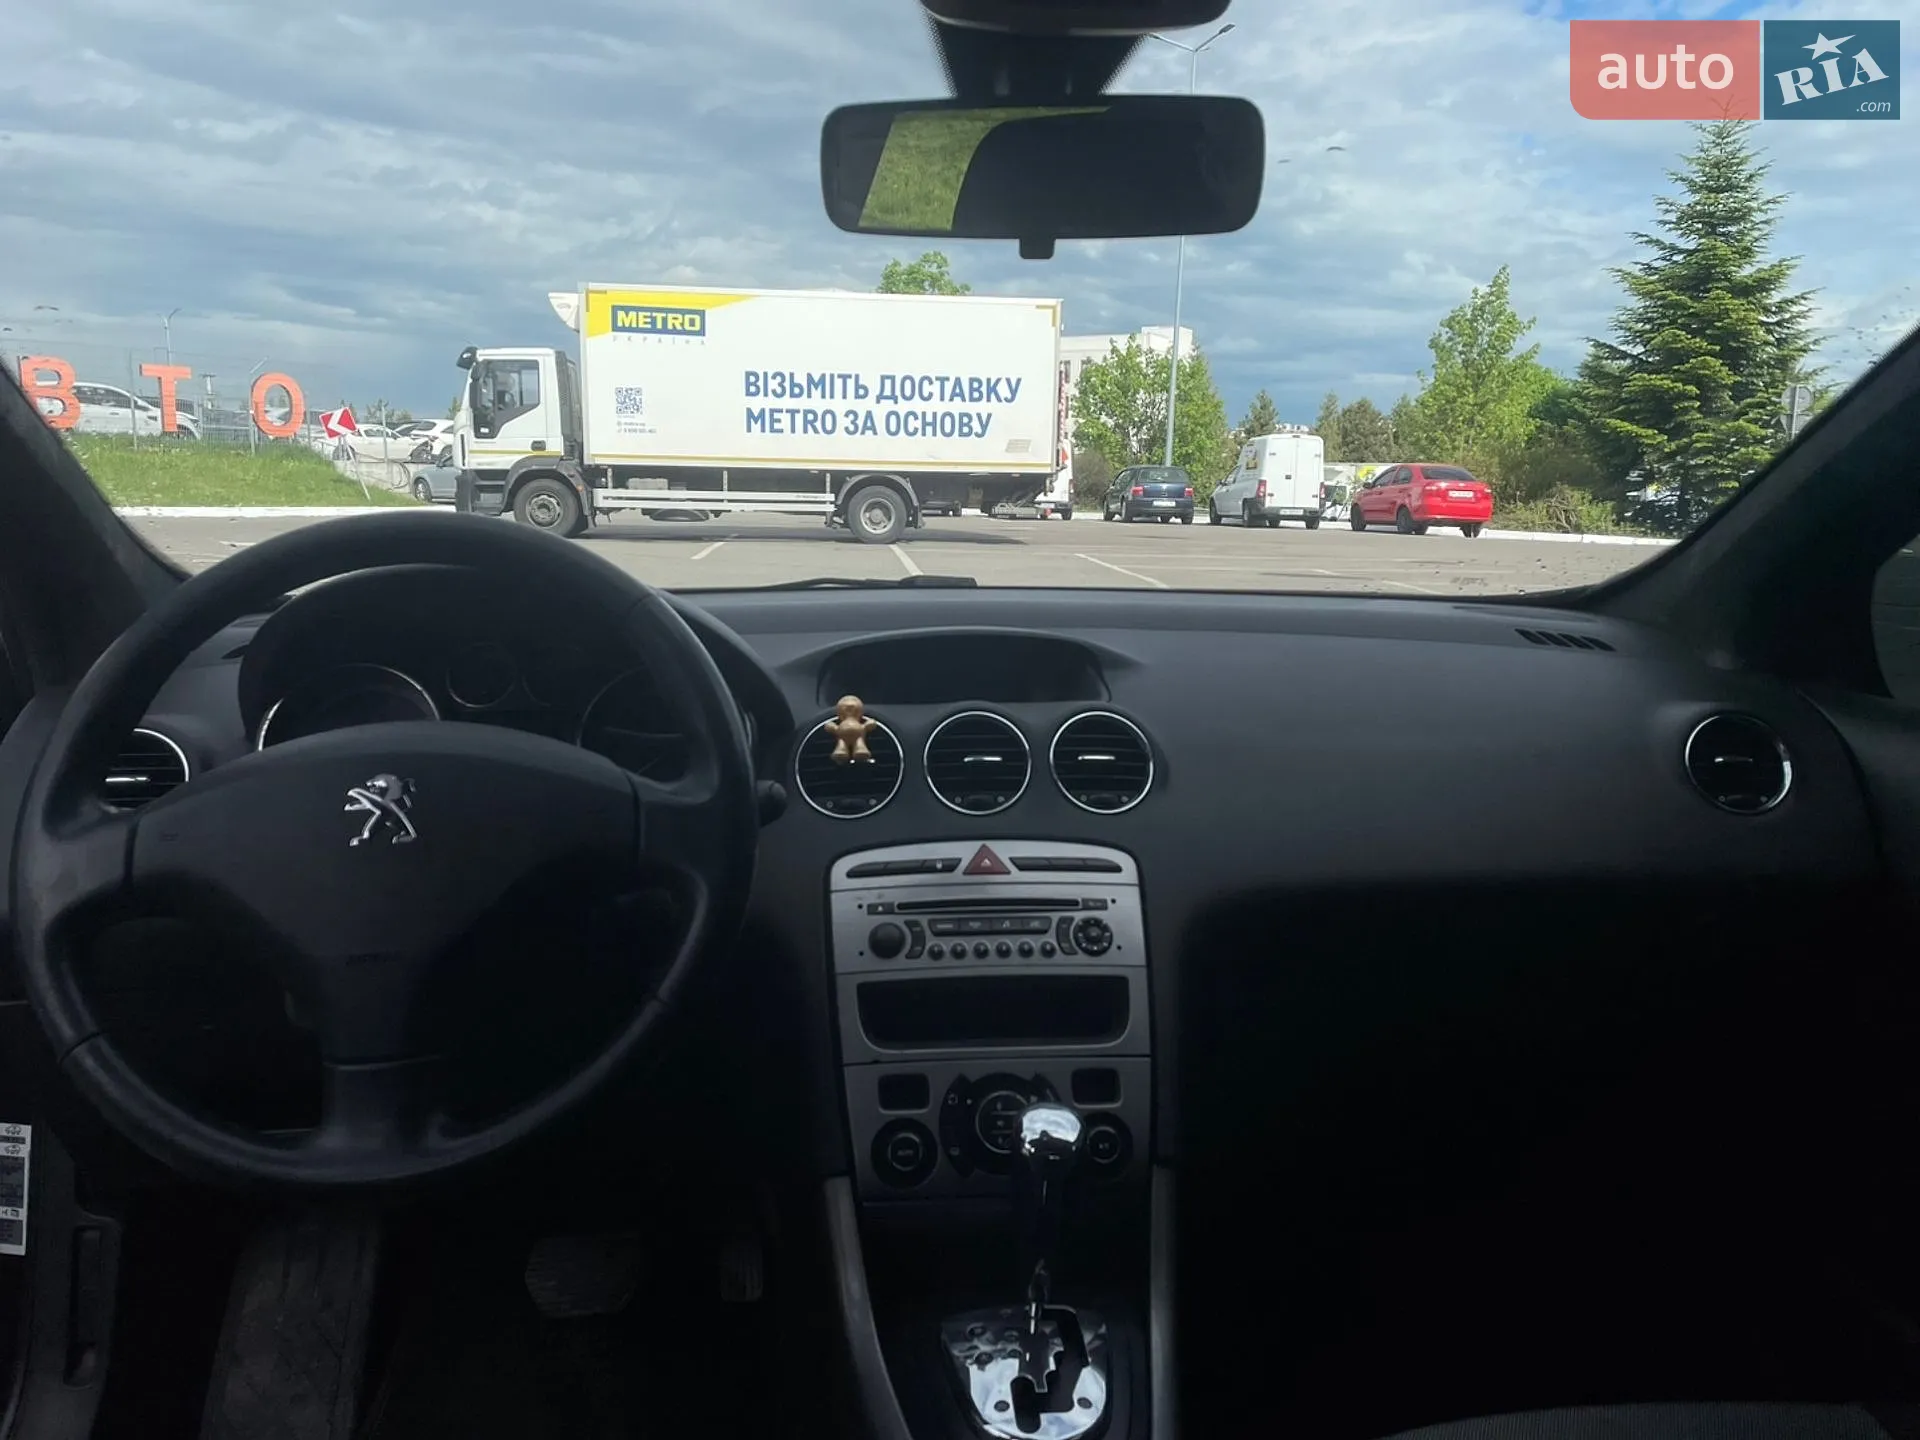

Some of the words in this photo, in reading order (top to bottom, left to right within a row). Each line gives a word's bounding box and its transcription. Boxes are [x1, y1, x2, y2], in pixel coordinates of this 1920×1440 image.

[616, 310, 701, 332] METRO
[744, 370, 870, 400] ВІЗЬМІТЬ
[875, 374, 1023, 405] ДОСТАВКУ
[745, 406, 838, 435] METRO
[843, 409, 878, 436] ЗА
[884, 410, 993, 439] ОСНОВУ
